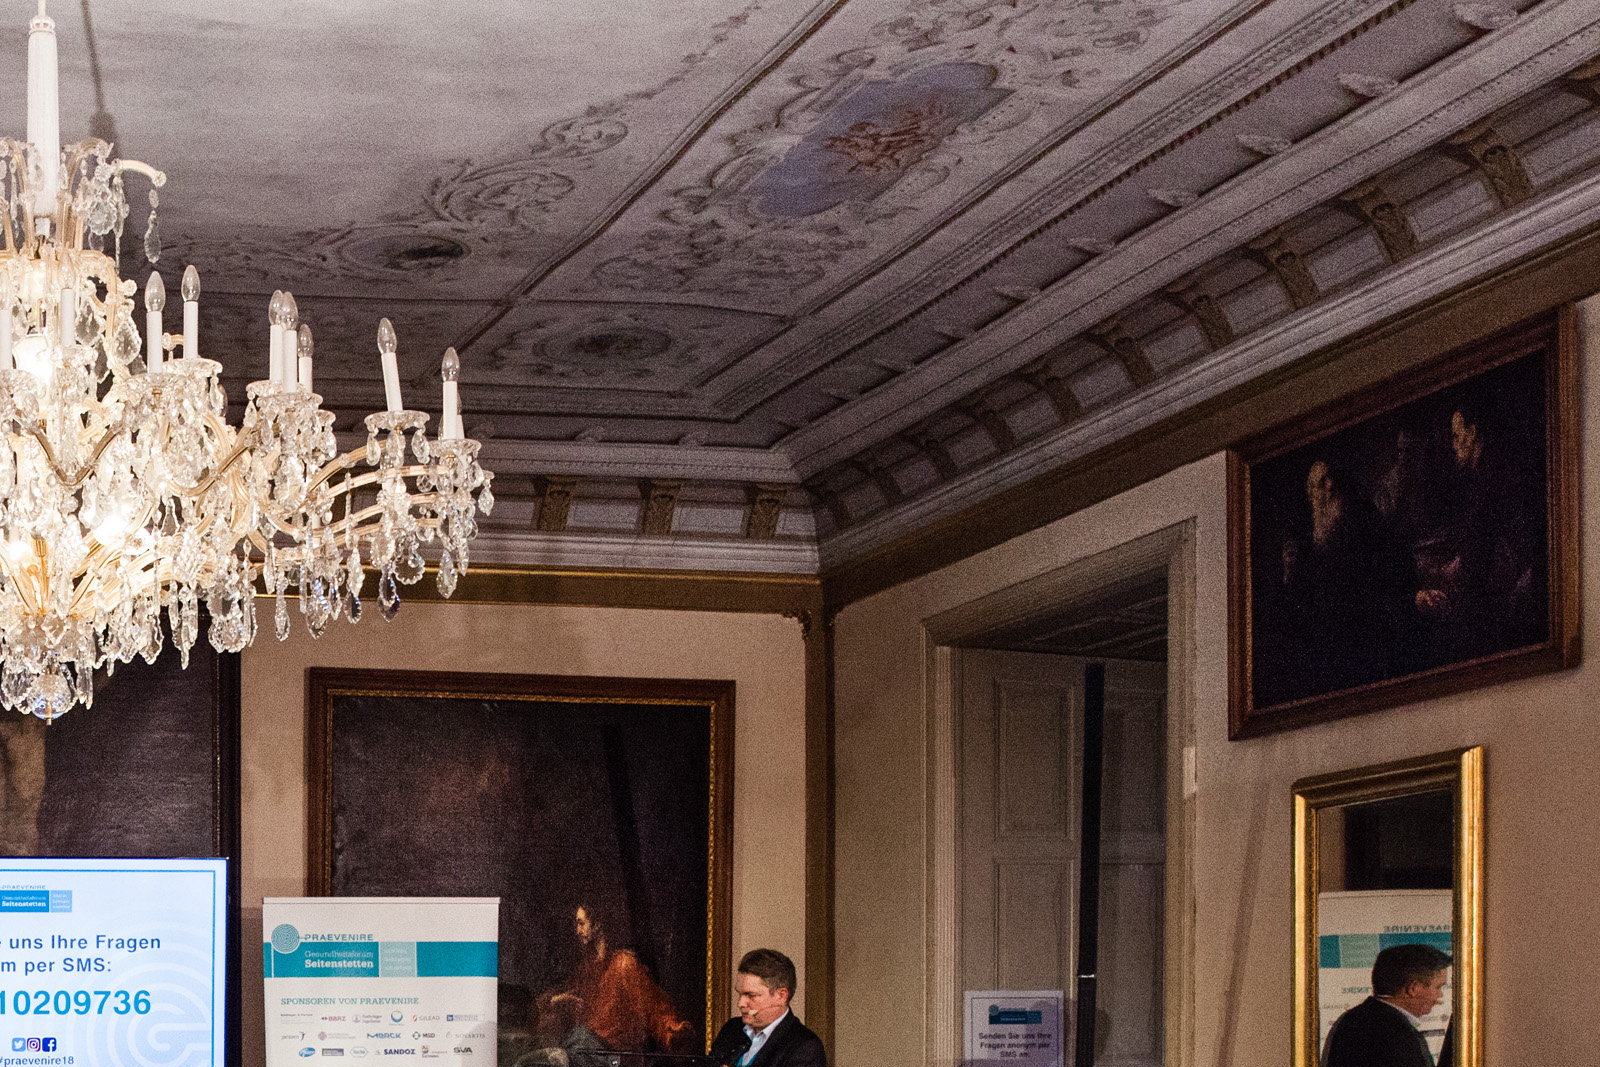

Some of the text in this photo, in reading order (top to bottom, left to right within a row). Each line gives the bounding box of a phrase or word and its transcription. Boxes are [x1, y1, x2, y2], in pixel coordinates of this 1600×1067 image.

[305, 933, 374, 941] PRAEVENIRE
[9, 938, 43, 950] uns
[51, 934, 88, 950] Ihre
[96, 934, 161, 953] Fragen
[24, 961, 55, 976] per
[62, 957, 111, 973] SMS:
[304, 959, 374, 968] Seitenstetten
[280, 997, 336, 1005] SPONSOREN
[359, 997, 420, 1005] PRAEVENIRE
[978, 1032, 1007, 1040] Senden
[1008, 1032, 1020, 1040] Sie
[980, 1041, 1005, 1049] Fragen
